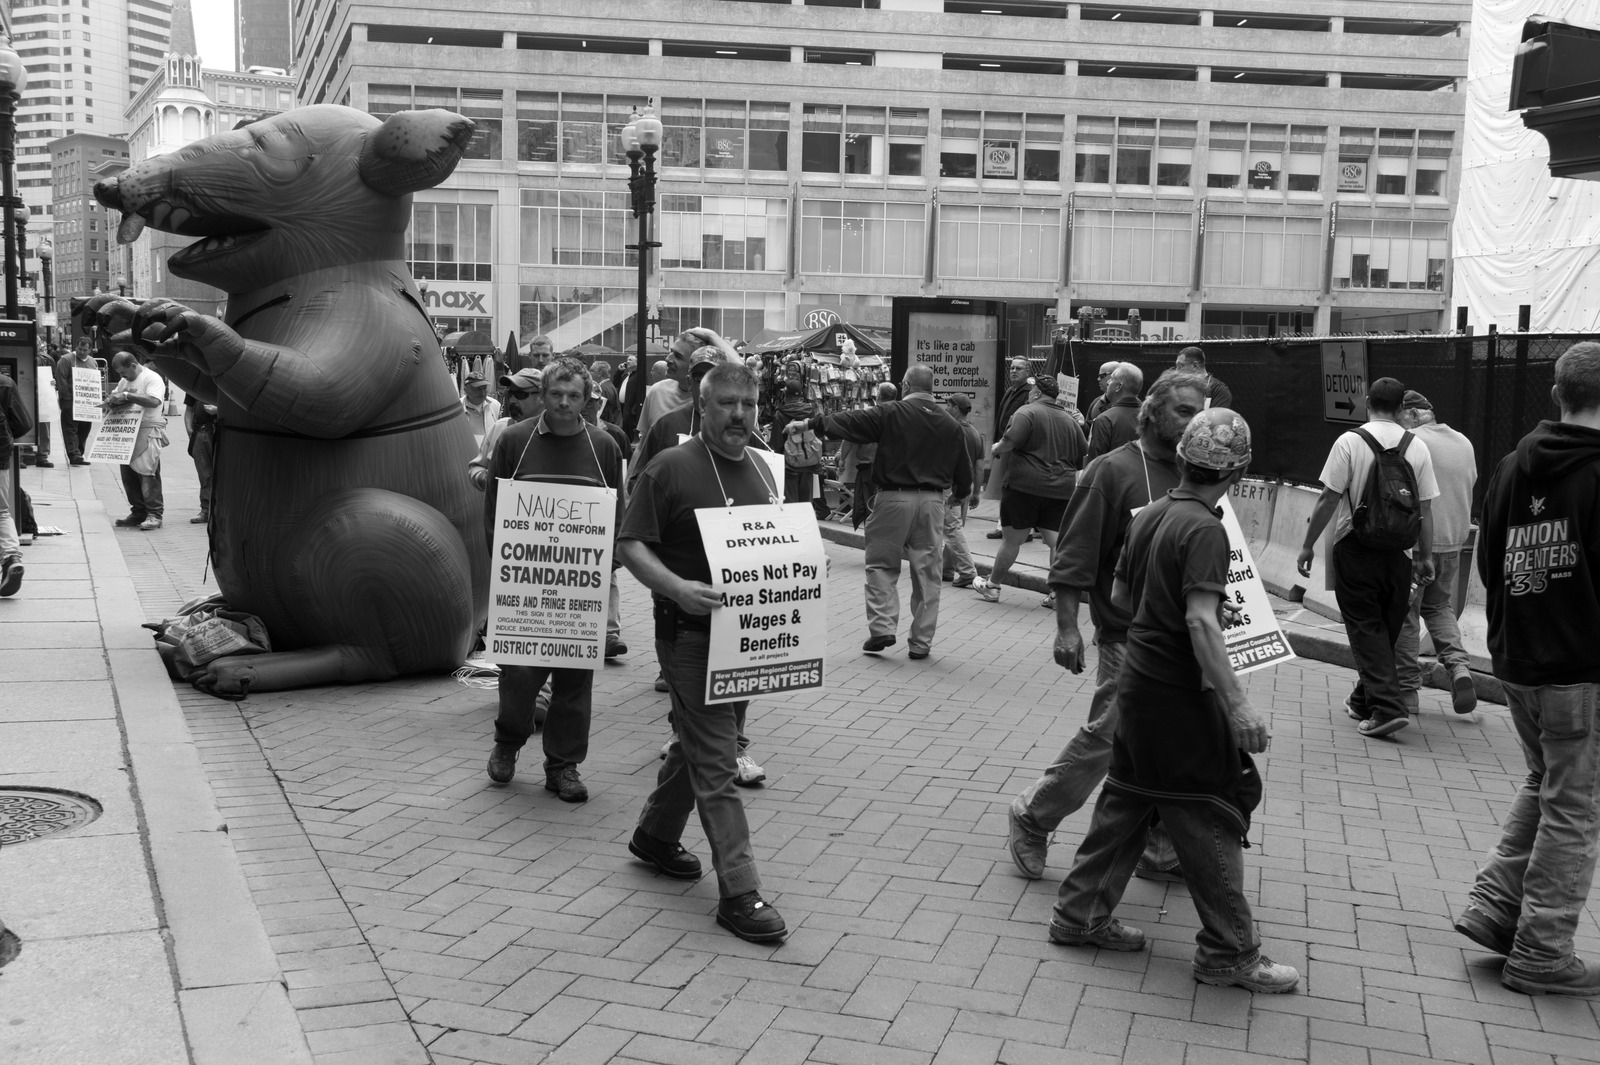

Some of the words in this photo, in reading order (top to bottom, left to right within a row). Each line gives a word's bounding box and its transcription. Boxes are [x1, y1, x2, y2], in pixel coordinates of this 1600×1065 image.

[992, 151, 1008, 163] BSC
[1344, 166, 1359, 178] BSC
[809, 311, 836, 329] BSC
[917, 340, 930, 350] It's
[934, 340, 949, 350] like
[960, 341, 975, 351] cab
[916, 352, 942, 362] stand
[945, 352, 953, 362] in
[956, 355, 974, 365] your
[953, 366, 979, 377] except
[943, 377, 989, 388] comfortable.
[1326, 374, 1363, 394] DETOUR
[1197, 438, 1210, 448] 33
[517, 493, 600, 524] NAUSET
[503, 519, 530, 530] DOES
[534, 522, 554, 532] NOT
[559, 523, 605, 535] CONFORM
[742, 521, 775, 531] R&A
[726, 535, 799, 548] DRYWALL
[501, 542, 604, 566] COMMUNITY
[1230, 549, 1243, 562] ay
[1504, 544, 1576, 572] RPENTERS
[500, 565, 601, 588] STANDARDS
[722, 568, 758, 584] Does
[763, 564, 788, 580] Not
[793, 563, 817, 579] Pay
[1510, 570, 1547, 596] 33
[496, 594, 520, 607] WAGES
[523, 596, 538, 608] AND
[541, 597, 566, 610] FRINGE
[569, 599, 602, 612] BENEFITS
[720, 592, 753, 607] Area
[759, 584, 821, 604] Standard
[1235, 590, 1245, 604] &
[497, 617, 546, 625] ORGANIZATIONAL
[739, 613, 786, 630] Wages
[791, 609, 801, 624] &
[186, 625, 208, 640] Big
[1227, 630, 1246, 639] projects
[740, 633, 799, 652] Benefits
[1251, 635, 1271, 646] Council
[493, 640, 538, 655] DISTRICT
[541, 643, 583, 658] COUNCIL
[586, 646, 598, 659] 35
[1228, 641, 1285, 668] ENTERS
[732, 669, 758, 678] England
[760, 666, 787, 675] Regional
[713, 670, 819, 695] CARPENTERS
